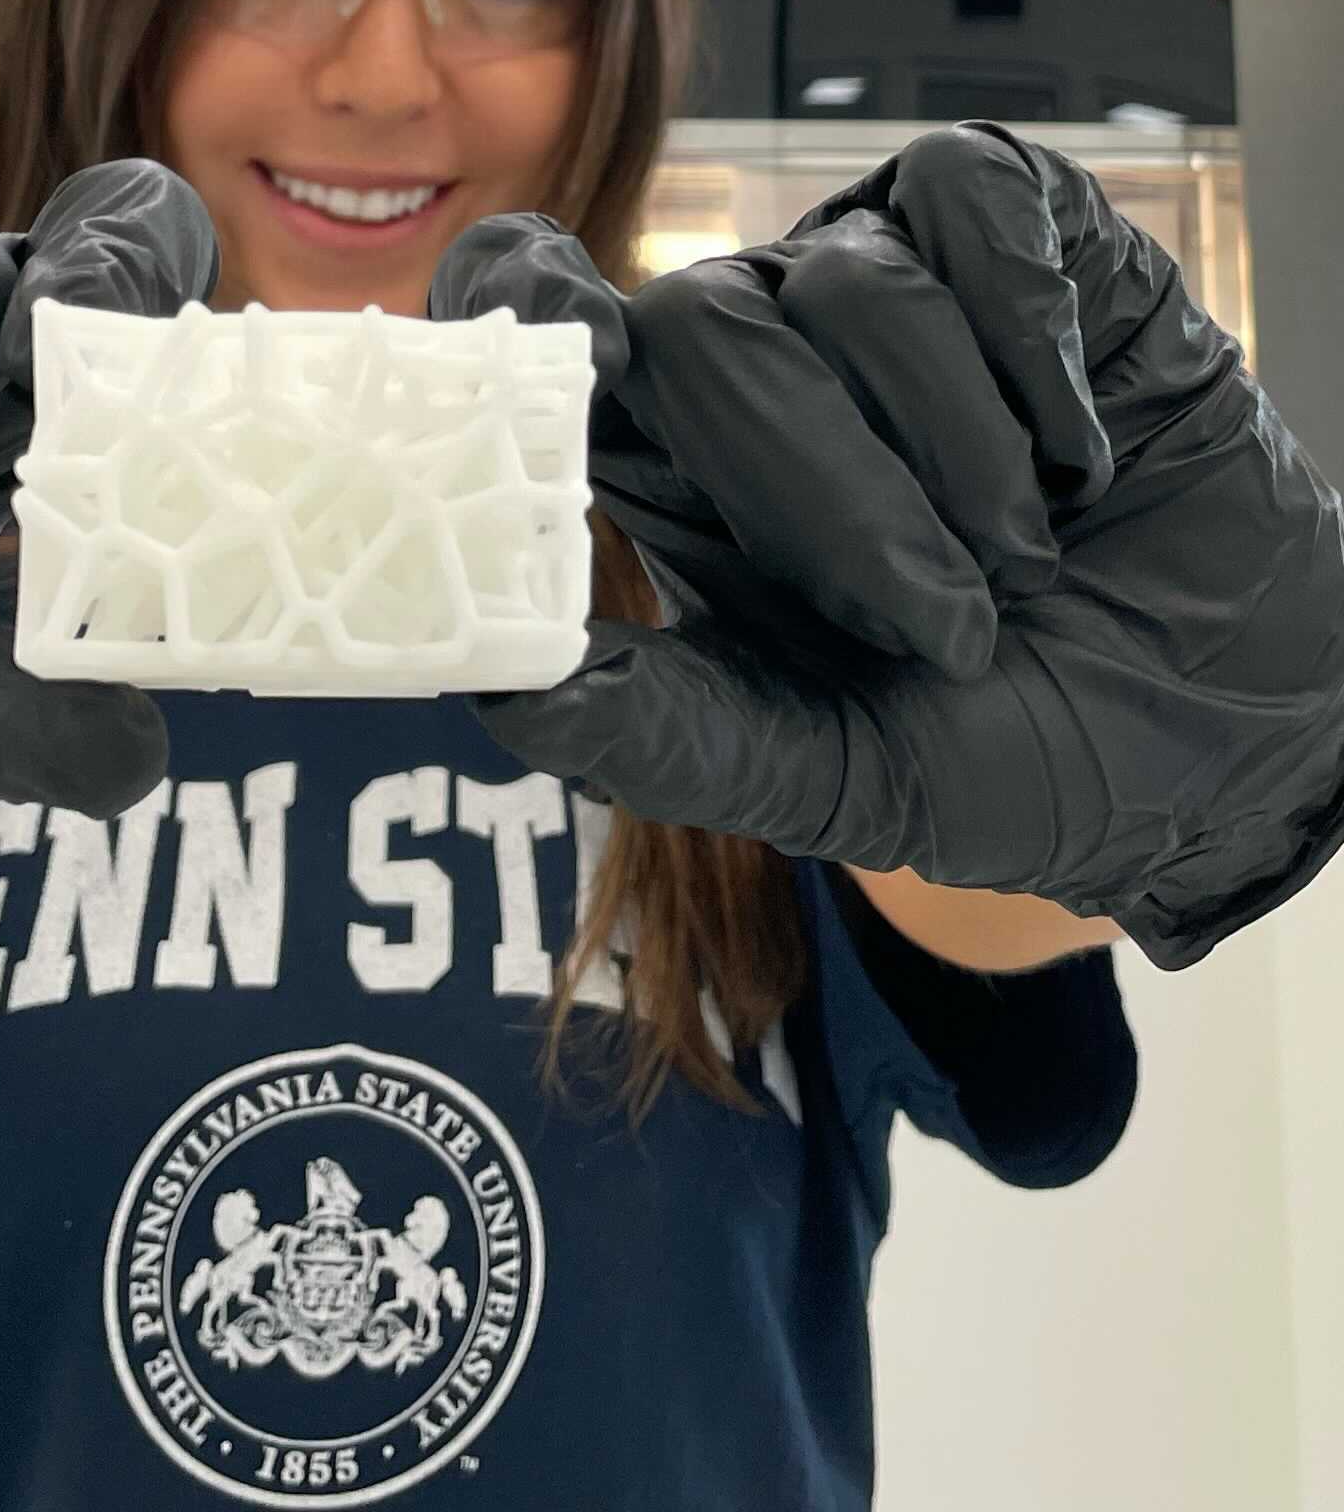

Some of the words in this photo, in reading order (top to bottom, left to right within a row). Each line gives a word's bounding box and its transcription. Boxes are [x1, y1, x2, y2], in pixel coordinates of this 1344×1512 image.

[355, 1071, 483, 1163] STATE
[129, 1070, 345, 1343] PENNSYLVANIA
[411, 1160, 523, 1450] UNIVERSITY
[144, 1348, 217, 1448] THE
[255, 1445, 359, 1485] 1855
